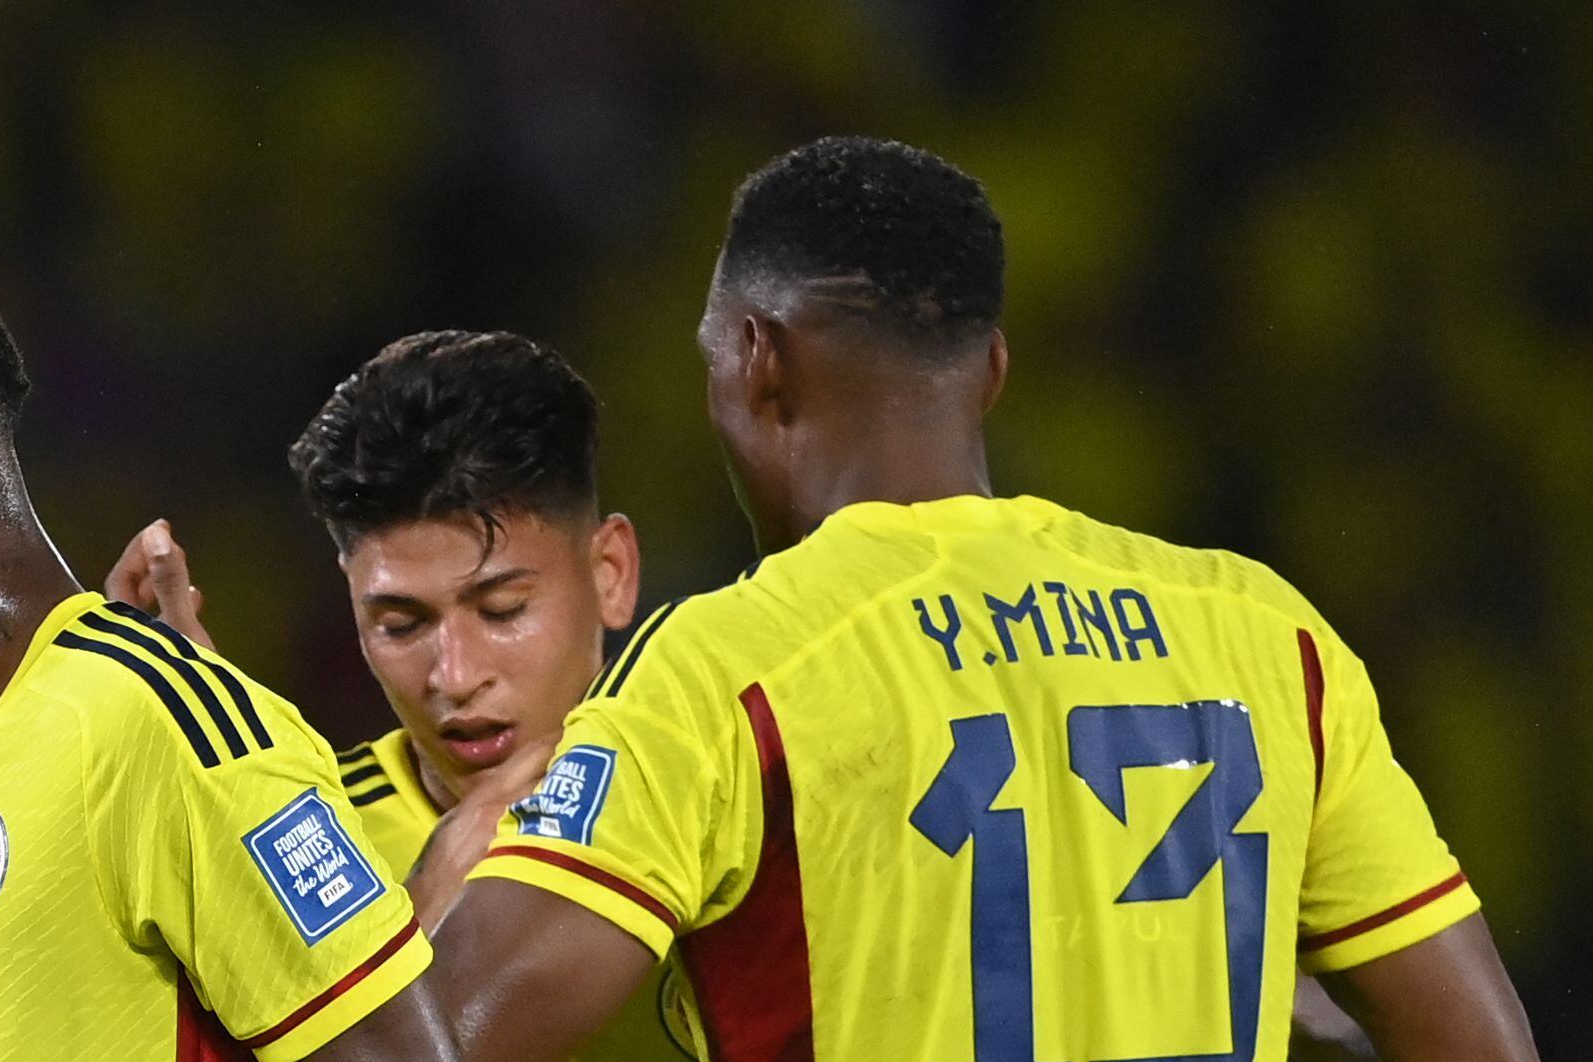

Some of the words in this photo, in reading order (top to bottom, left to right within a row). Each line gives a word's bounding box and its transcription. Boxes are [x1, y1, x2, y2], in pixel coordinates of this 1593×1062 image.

[911, 580, 1170, 671] Y.MINA
[272, 813, 322, 857] FOOTBALL
[282, 829, 334, 877] UNITES
[292, 874, 318, 898] the
[313, 846, 350, 883] World
[323, 881, 346, 901] FIFA
